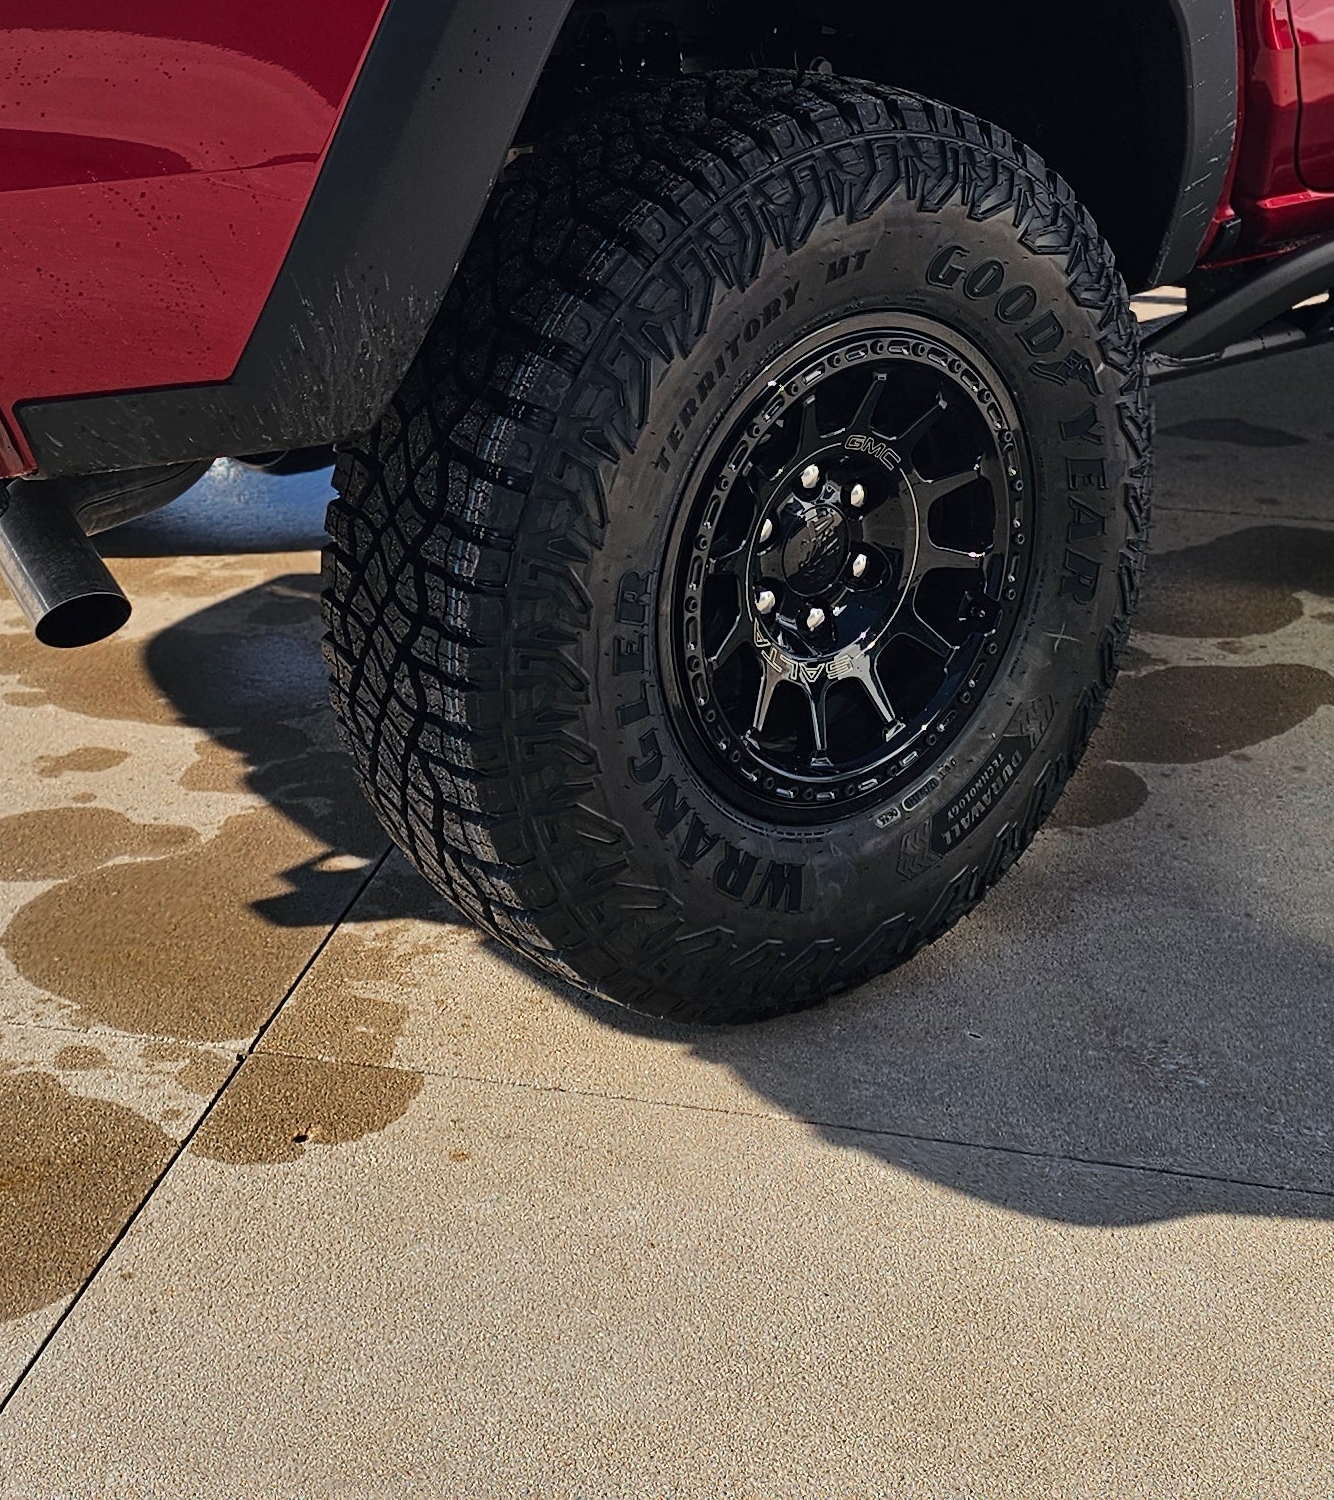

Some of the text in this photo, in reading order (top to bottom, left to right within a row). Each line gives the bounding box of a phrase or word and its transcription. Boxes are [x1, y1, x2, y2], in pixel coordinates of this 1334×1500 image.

[651, 280, 801, 474] TERRITORY
[825, 249, 871, 284] MT
[844, 434, 902, 471] GMC
[613, 570, 805, 914] WRANGLER
[946, 752, 1007, 822] TECHNOLOGY
[942, 749, 1024, 846] DURAWALL
